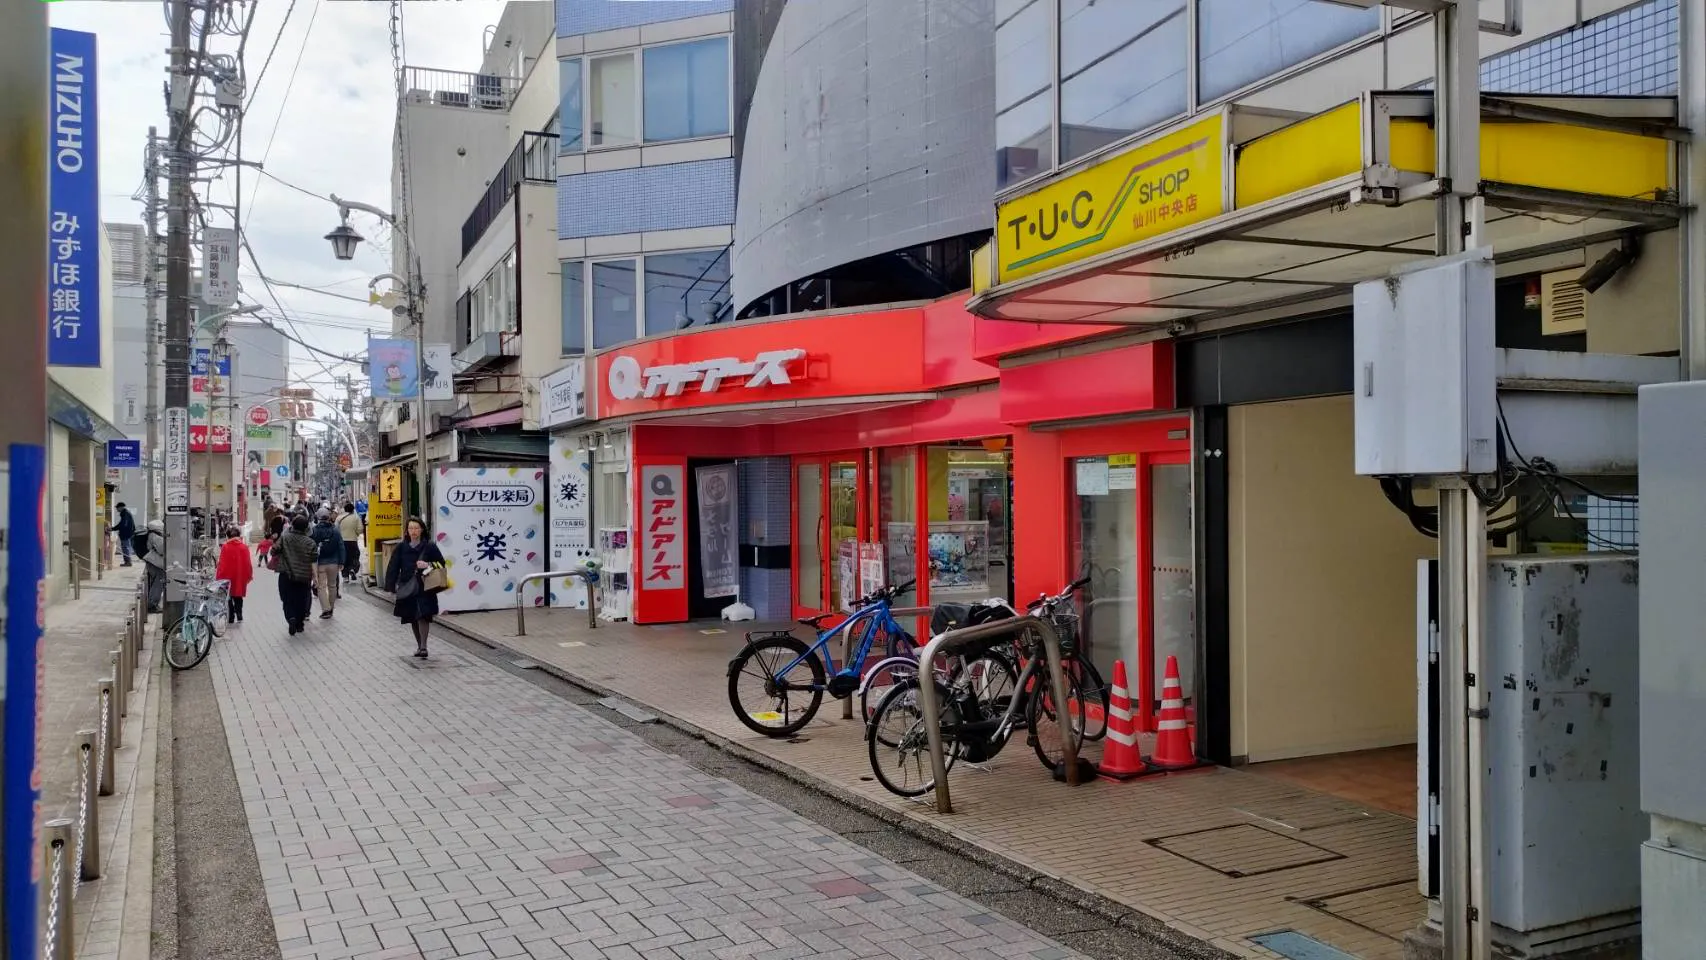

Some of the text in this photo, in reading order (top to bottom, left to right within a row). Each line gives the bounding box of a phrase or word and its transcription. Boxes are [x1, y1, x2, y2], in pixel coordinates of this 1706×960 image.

[56, 52, 84, 174] MIZUHO
[1139, 168, 1190, 205] SHOP
[1132, 194, 1198, 231] 仙川中央店
[51, 211, 82, 340] みずほ銀行
[561, 482, 578, 501] 楽
[476, 531, 507, 561] 楽
[645, 499, 681, 581] アドアーズ
